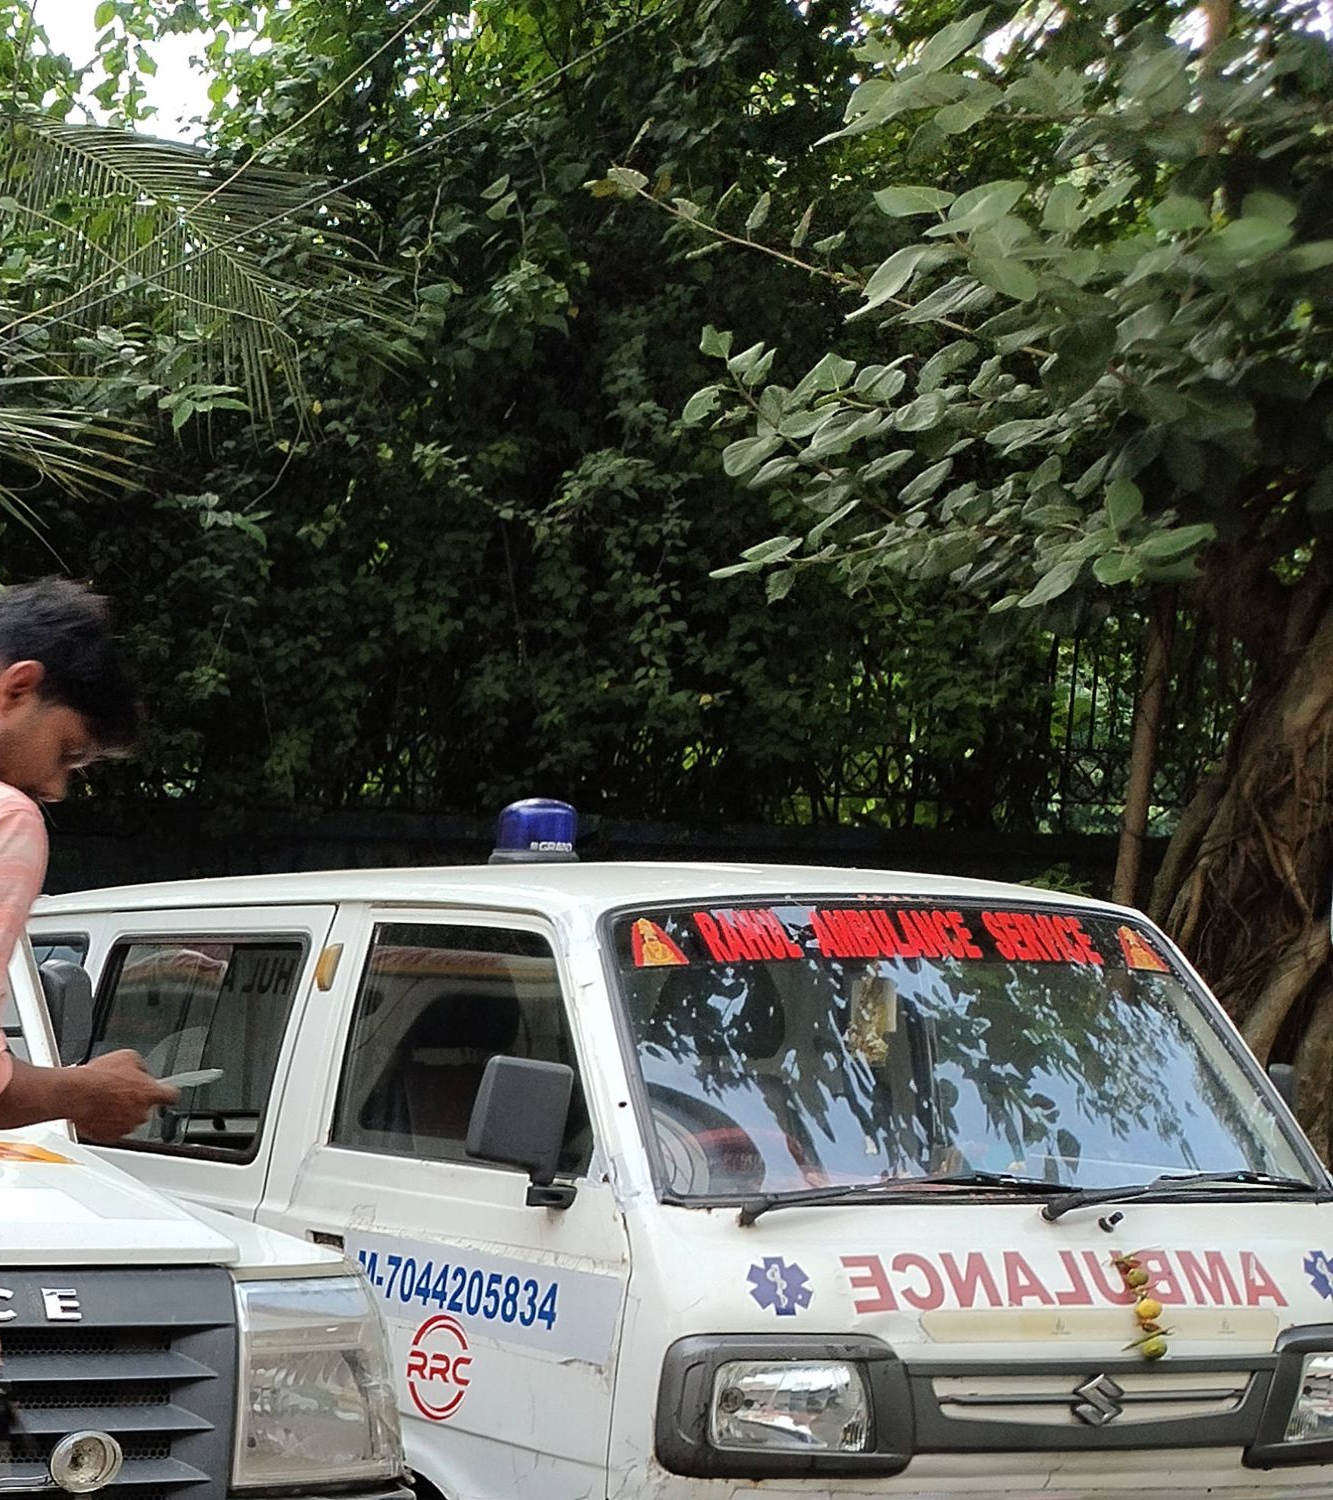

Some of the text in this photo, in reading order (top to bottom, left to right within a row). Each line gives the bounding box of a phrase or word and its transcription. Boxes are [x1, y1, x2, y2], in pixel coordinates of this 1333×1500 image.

[694, 908, 1105, 965] RAHUL AMBULANCE SERVICE
[406, 1350, 473, 1387] RRC
